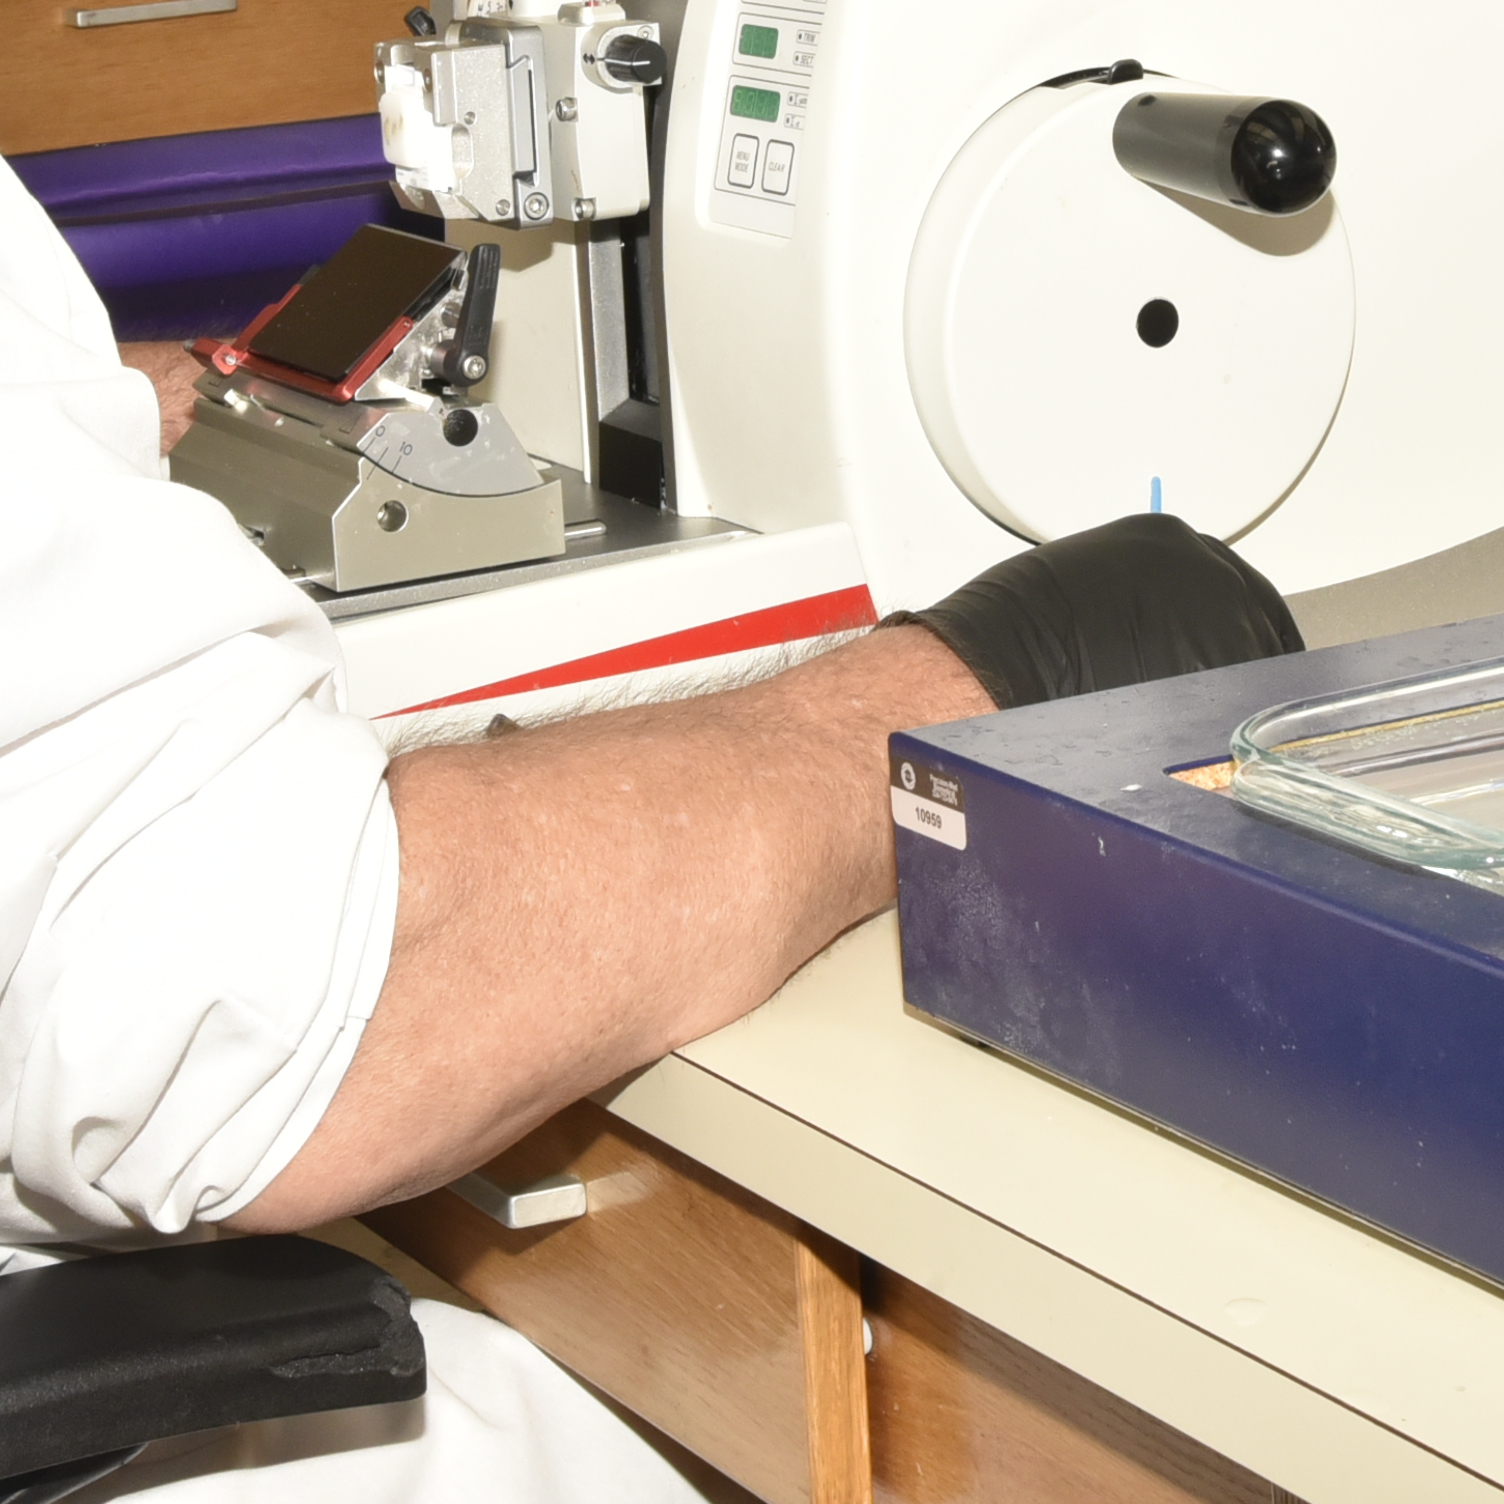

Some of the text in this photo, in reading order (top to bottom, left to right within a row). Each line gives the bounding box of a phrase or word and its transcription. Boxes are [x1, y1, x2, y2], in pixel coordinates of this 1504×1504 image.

[804, 32, 816, 43] TRIM
[736, 151, 750, 162] MENU
[734, 162, 749, 173] MODE
[768, 161, 785, 173] CLEAR
[375, 425, 385, 437] 0
[399, 441, 413, 456] 10
[915, 806, 942, 829] 10959
